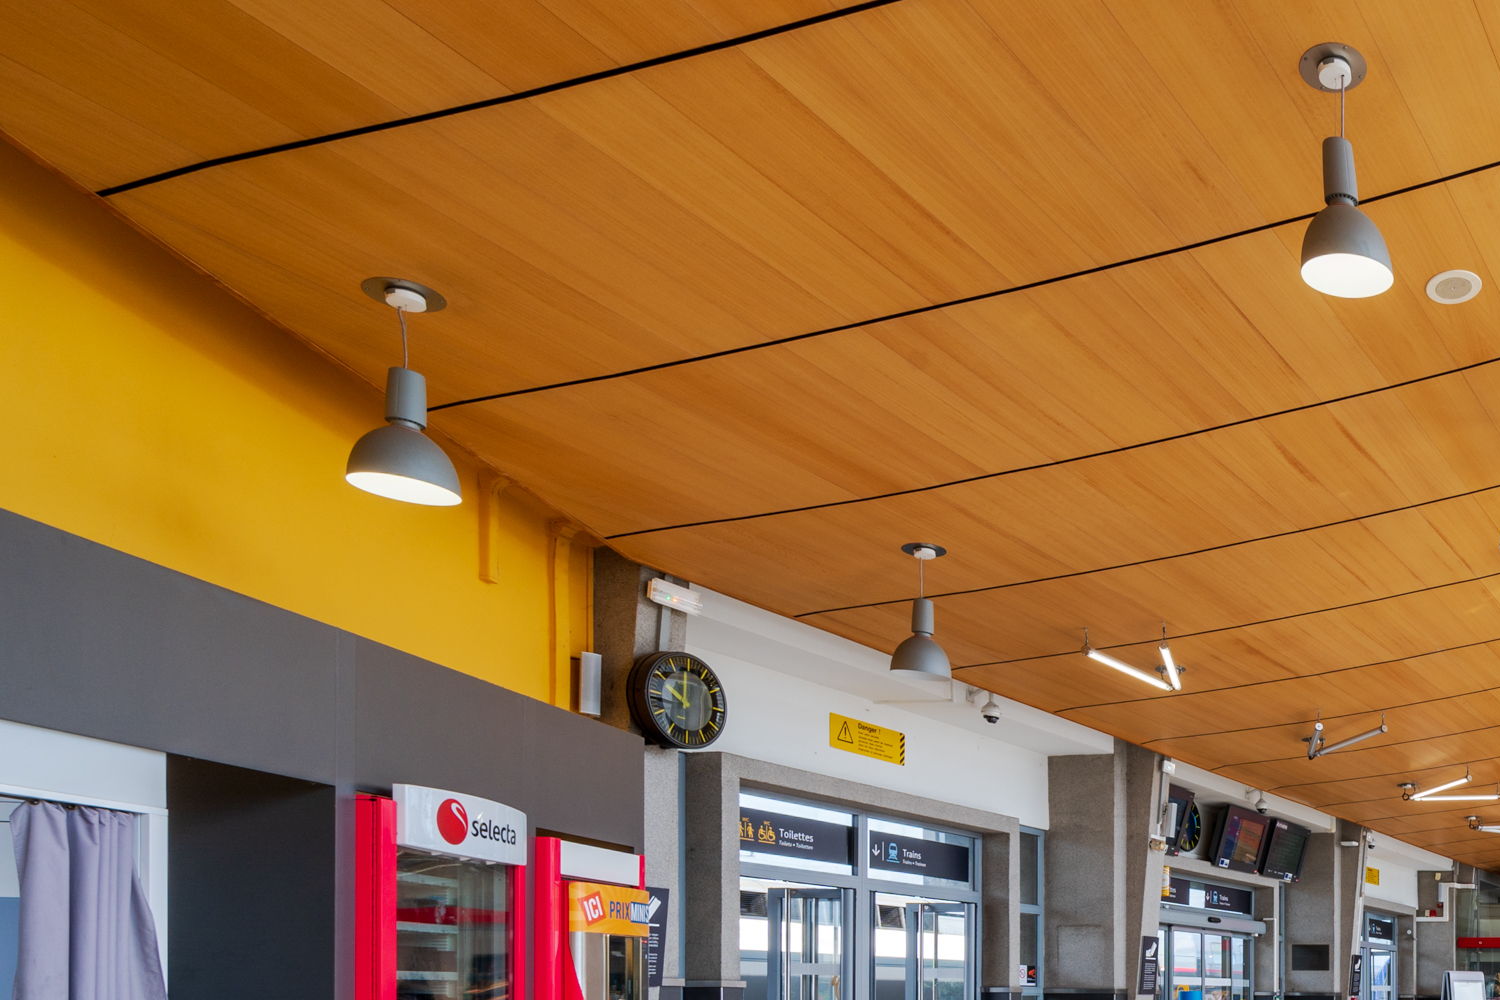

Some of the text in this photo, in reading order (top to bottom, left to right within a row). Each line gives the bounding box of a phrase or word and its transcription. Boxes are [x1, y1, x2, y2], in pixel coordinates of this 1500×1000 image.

[858, 723, 877, 734] Danger
[471, 819, 516, 845] selecta
[779, 828, 814, 843] Toilettes
[902, 848, 922, 860] Trains
[583, 895, 603, 921] ICI
[609, 901, 650, 923] PRIX MINIS
